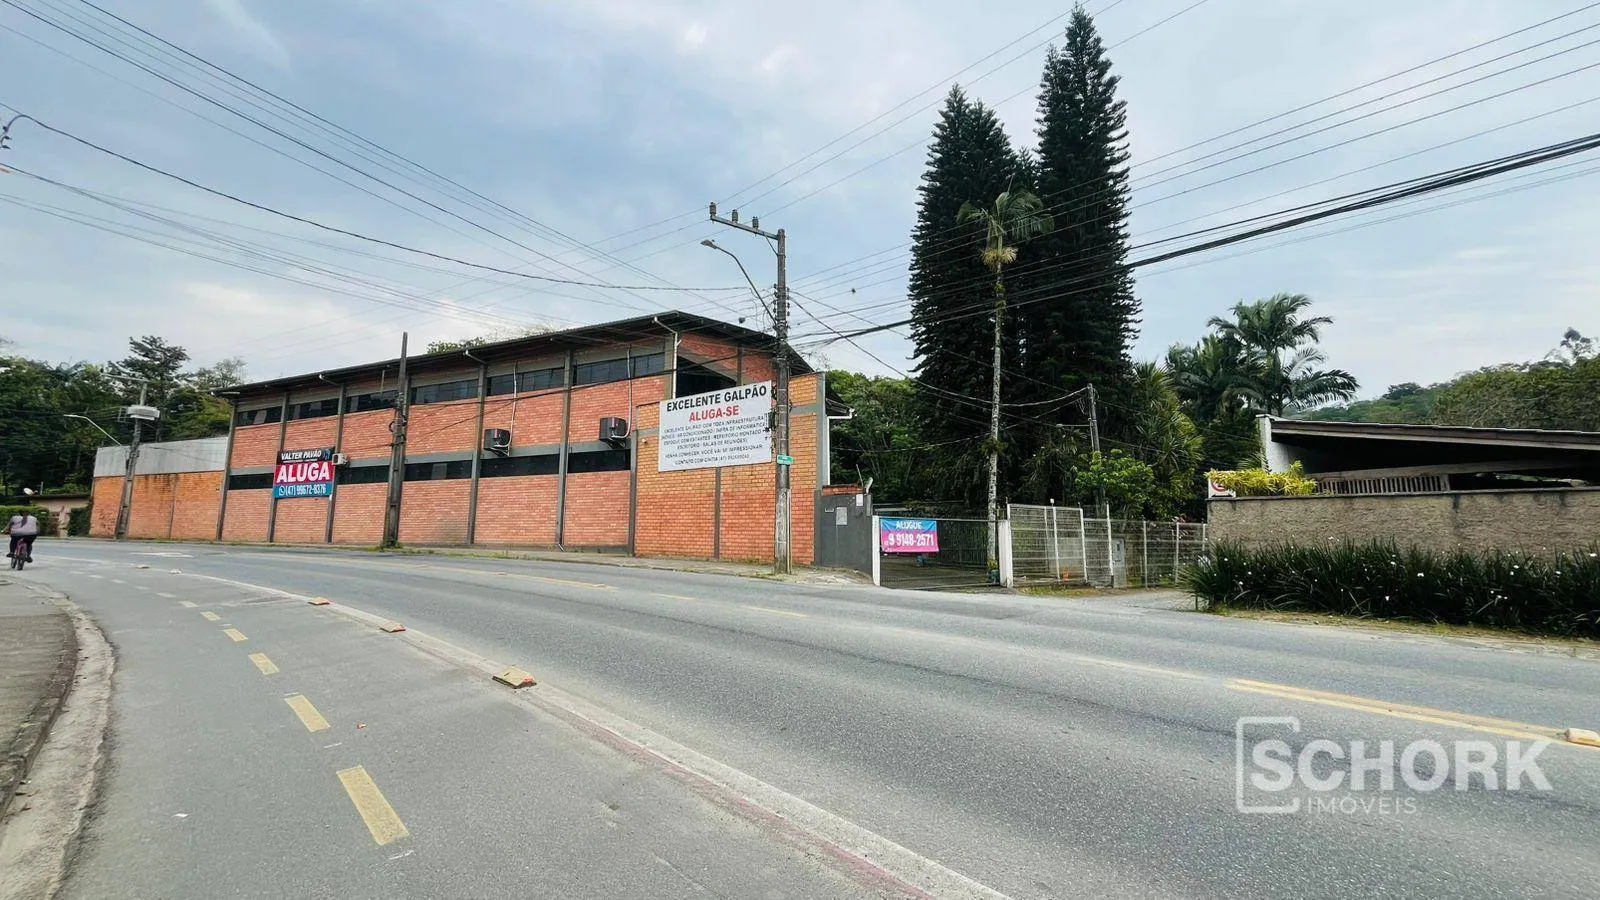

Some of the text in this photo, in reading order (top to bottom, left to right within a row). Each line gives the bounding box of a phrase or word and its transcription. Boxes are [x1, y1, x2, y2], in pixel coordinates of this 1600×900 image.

[666, 385, 767, 412] EXCELENTE GALPÃO
[689, 405, 739, 422] ALUGA-SE
[281, 452, 302, 460] VALTER
[276, 462, 331, 483] ALUGA
[895, 520, 922, 530] ALUGUE
[896, 533, 935, 547] 9148-2571
